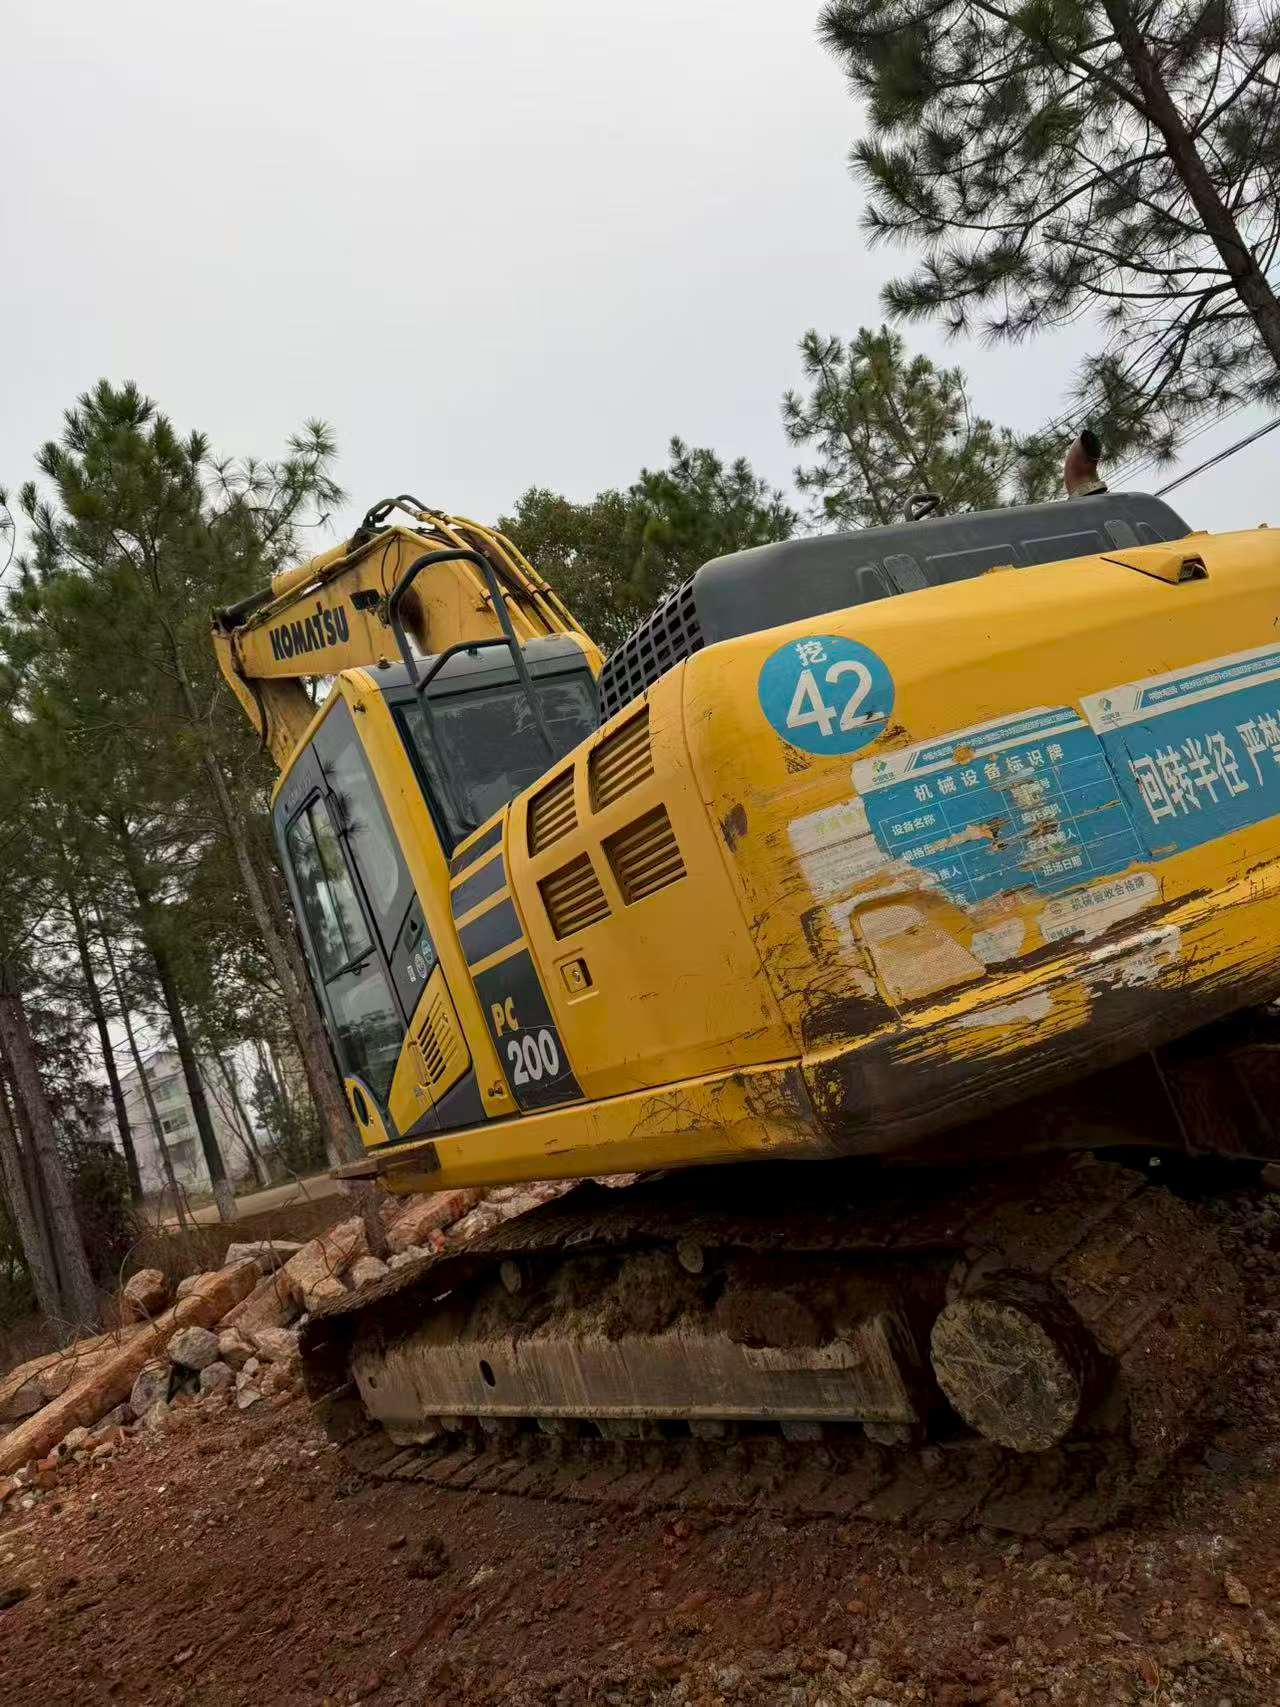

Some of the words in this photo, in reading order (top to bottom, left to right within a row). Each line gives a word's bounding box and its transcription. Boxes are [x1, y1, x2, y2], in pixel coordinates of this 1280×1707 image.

[269, 601, 350, 661] KOMATSU
[795, 640, 828, 667] 挖
[786, 660, 885, 737] 42
[913, 742, 1065, 802] 机械设备标识牌
[1128, 730, 1250, 823] 回转半径
[892, 813, 936, 837] 设备名称
[1041, 854, 1082, 877] 进场日期
[491, 996, 519, 1037] PC
[507, 1029, 560, 1086] 200
